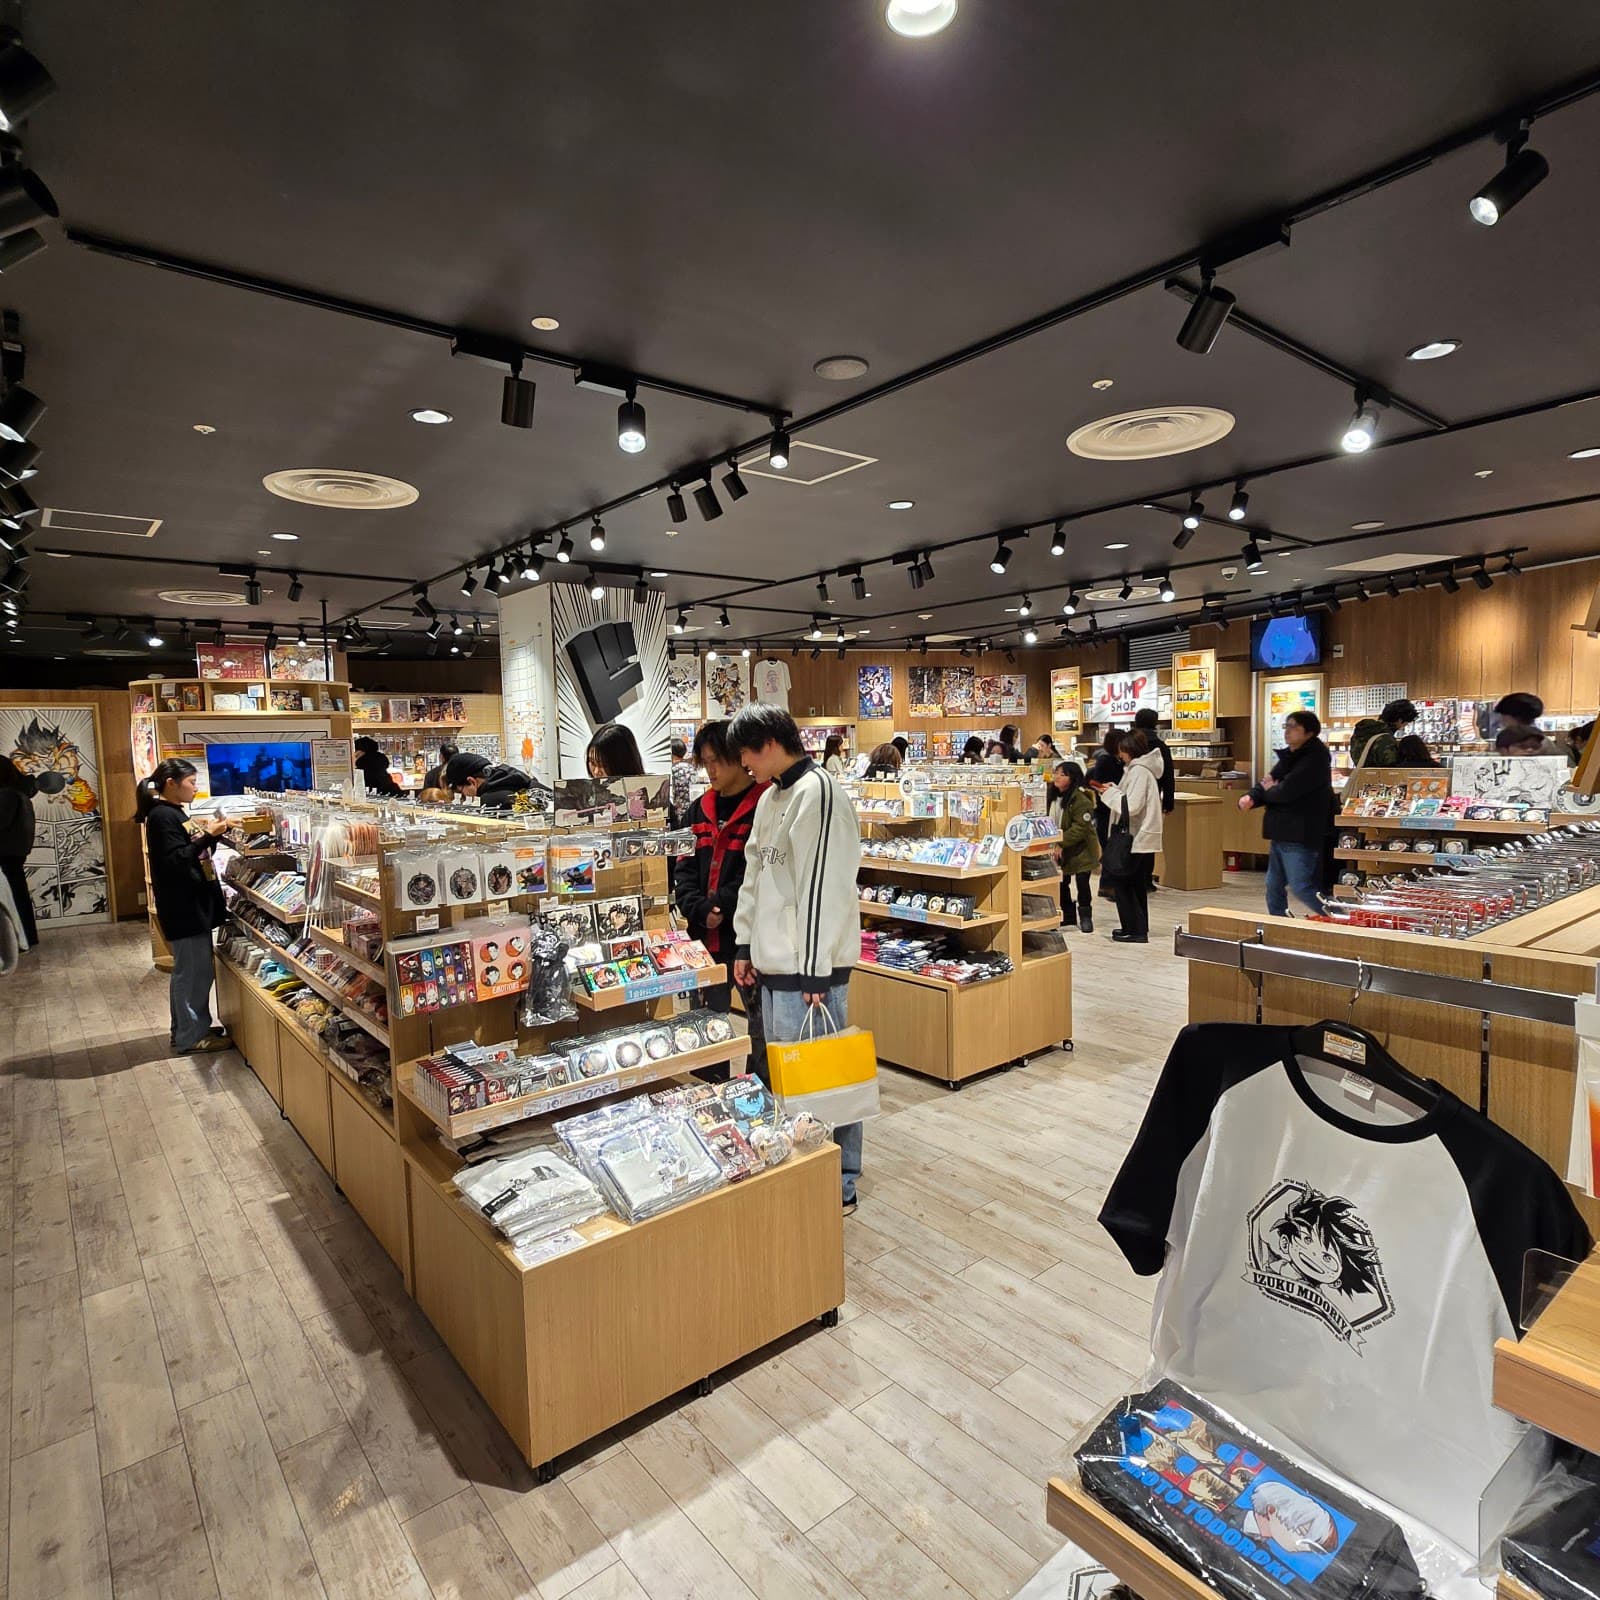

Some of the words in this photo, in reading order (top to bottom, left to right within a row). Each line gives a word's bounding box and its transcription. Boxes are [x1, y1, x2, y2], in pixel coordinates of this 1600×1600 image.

[1100, 676, 1147, 705] JUMP
[1111, 701, 1136, 712] SHOP
[1253, 1272, 1295, 1294] IZUKU
[1296, 1285, 1352, 1341] MIDORIYA
[1183, 1500, 1297, 1585] TODOROKI
